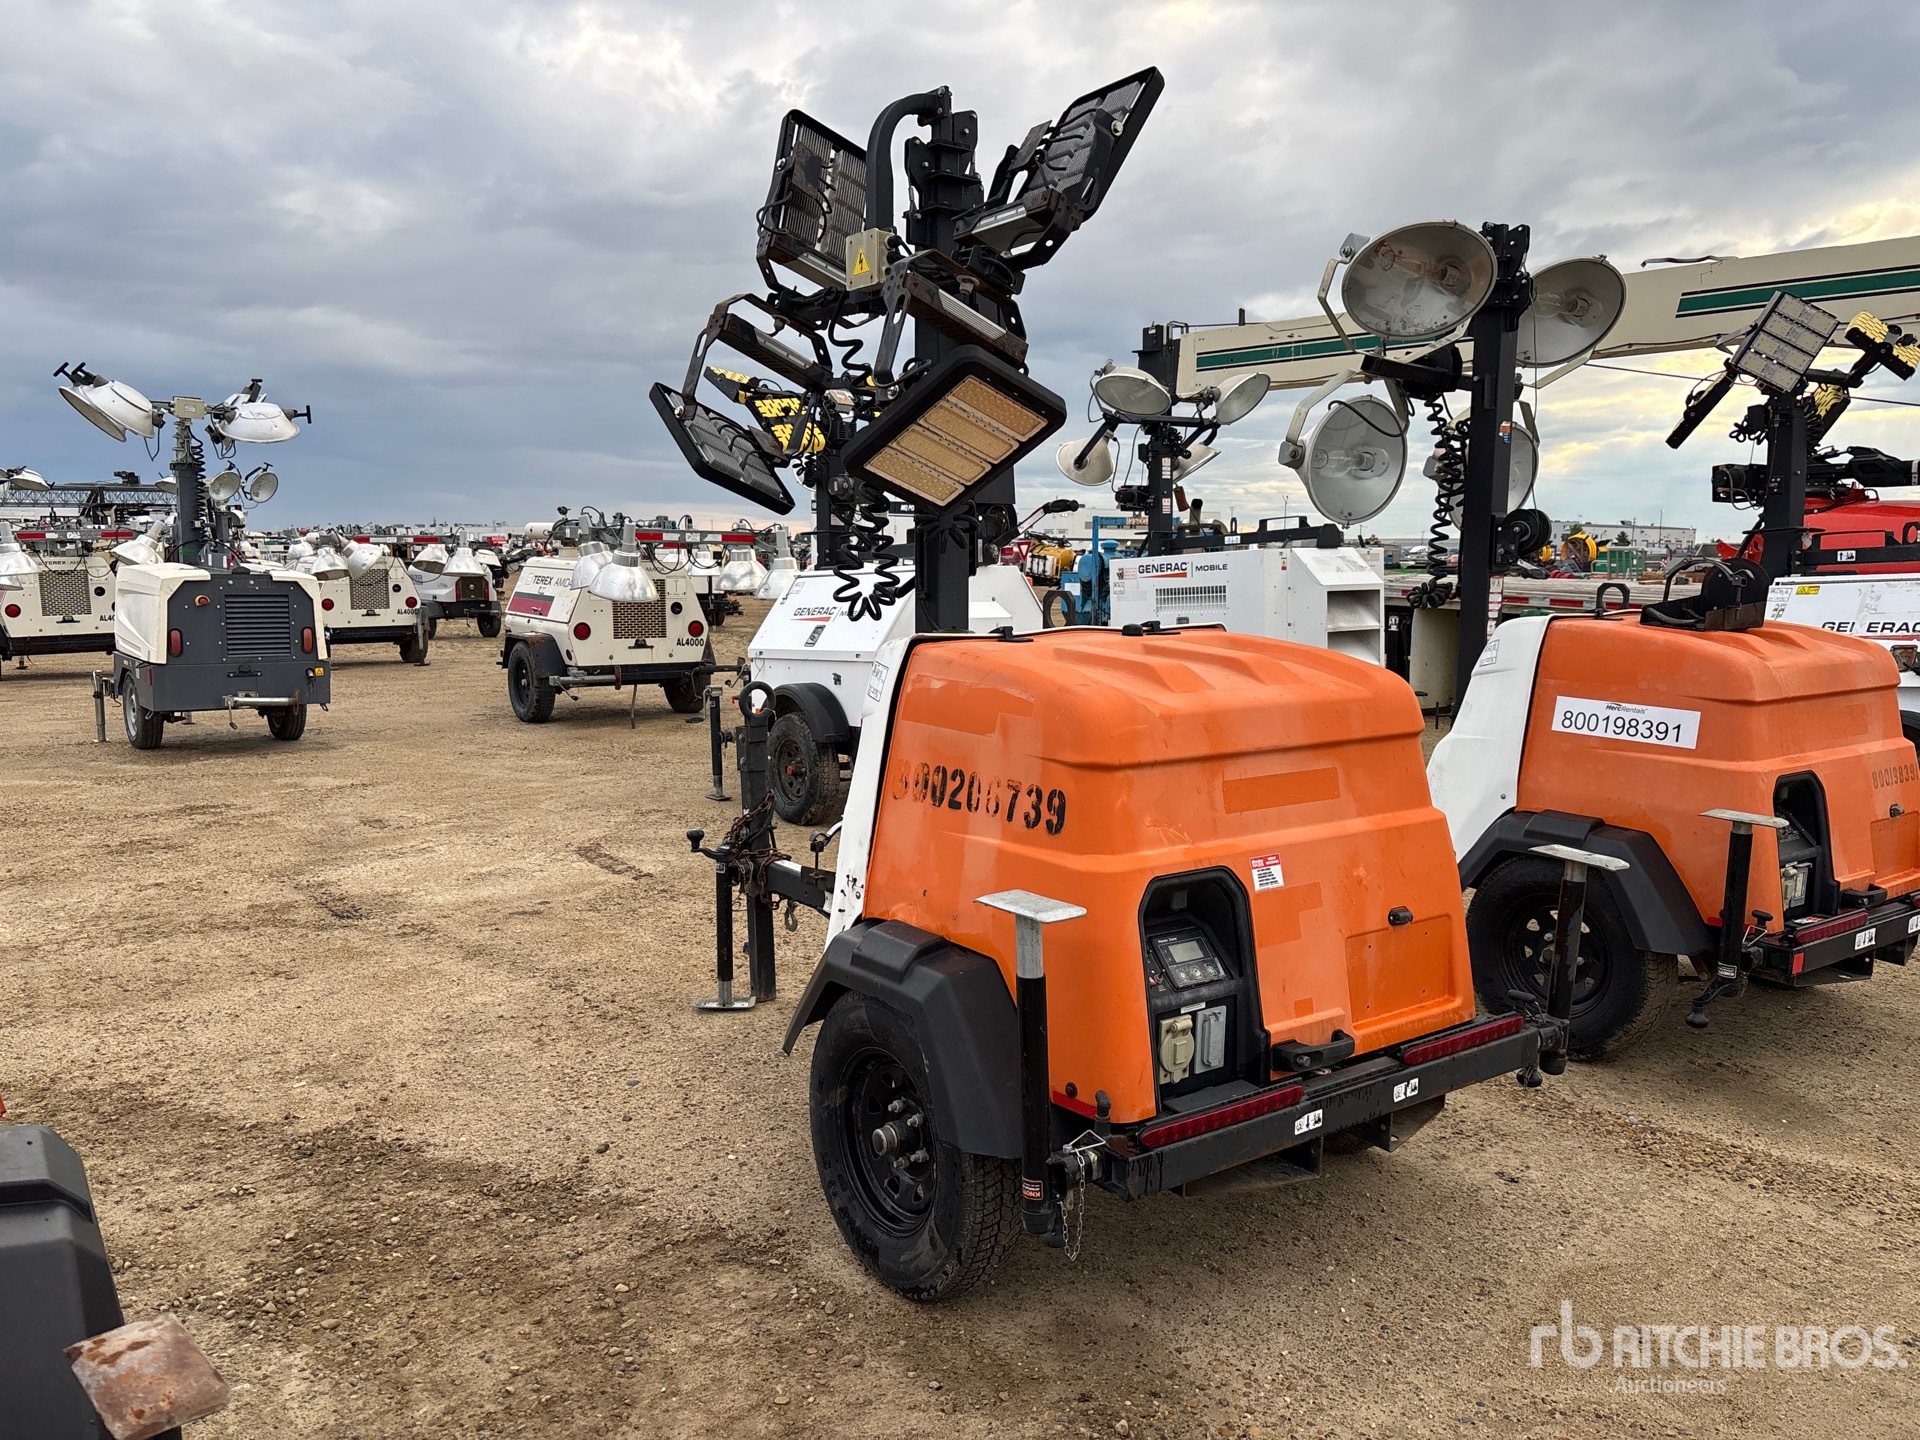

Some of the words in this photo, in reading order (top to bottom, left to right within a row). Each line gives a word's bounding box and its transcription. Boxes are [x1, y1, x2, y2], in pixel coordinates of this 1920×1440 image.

[1138, 562, 1188, 574] GENERAC
[1195, 563, 1228, 572] MOBILE
[532, 574, 553, 586] TEREX
[793, 606, 837, 617] GENERAC
[676, 638, 705, 647] AL4000
[1561, 710, 1682, 743] 800198391
[1871, 761, 1920, 789] 800198391
